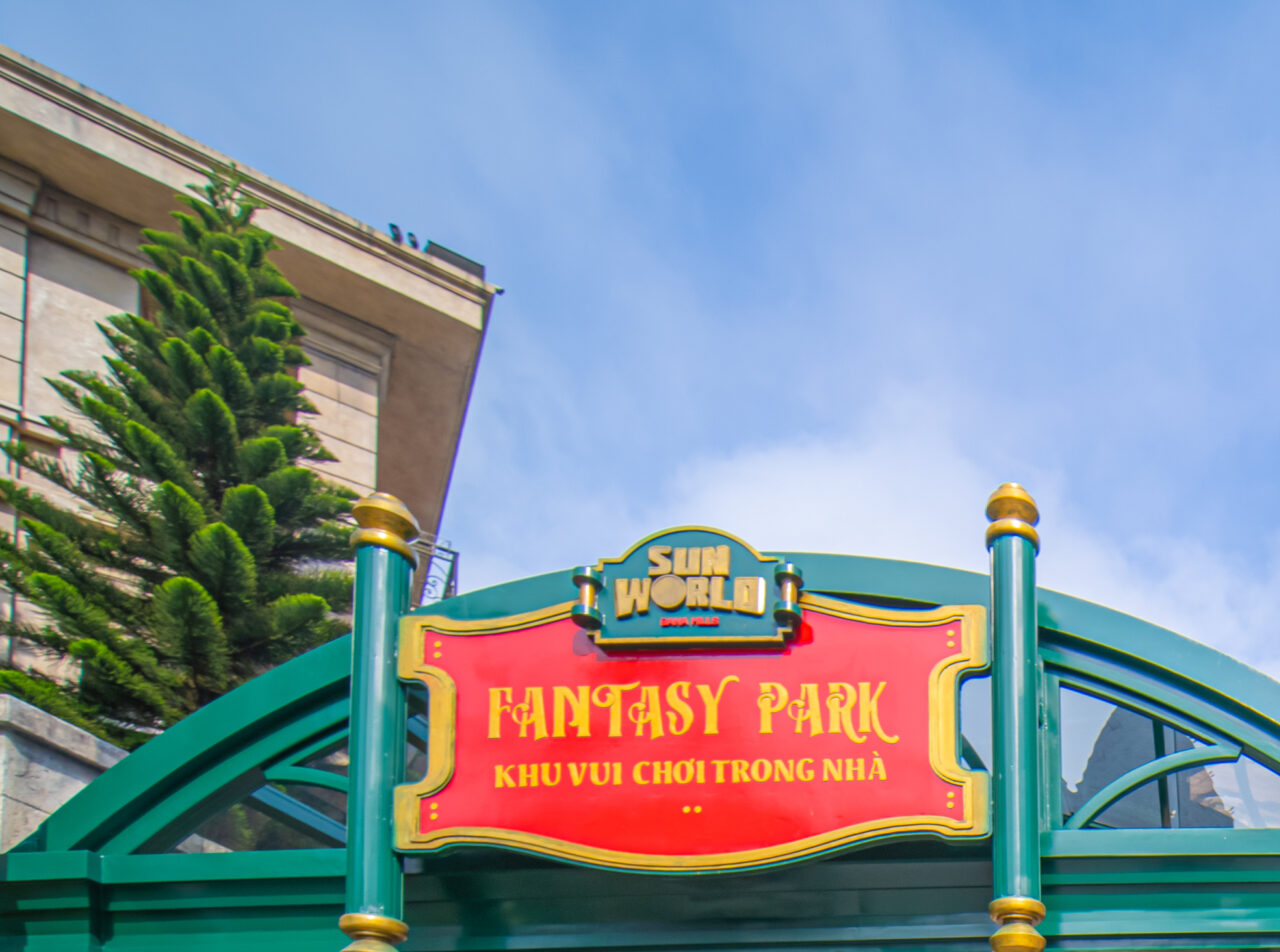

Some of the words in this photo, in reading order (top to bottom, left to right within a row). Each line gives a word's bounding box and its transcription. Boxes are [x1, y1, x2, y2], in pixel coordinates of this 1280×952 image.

[648, 545, 730, 577] SUN
[615, 574, 766, 619] WORLD
[488, 675, 739, 741] FANTASY
[757, 681, 900, 744] PARK
[494, 763, 561, 788] KHU
[567, 761, 622, 786] VUI
[632, 758, 706, 785] CHƠI
[711, 758, 815, 783] TRONG
[822, 750, 887, 782] NHÀ
